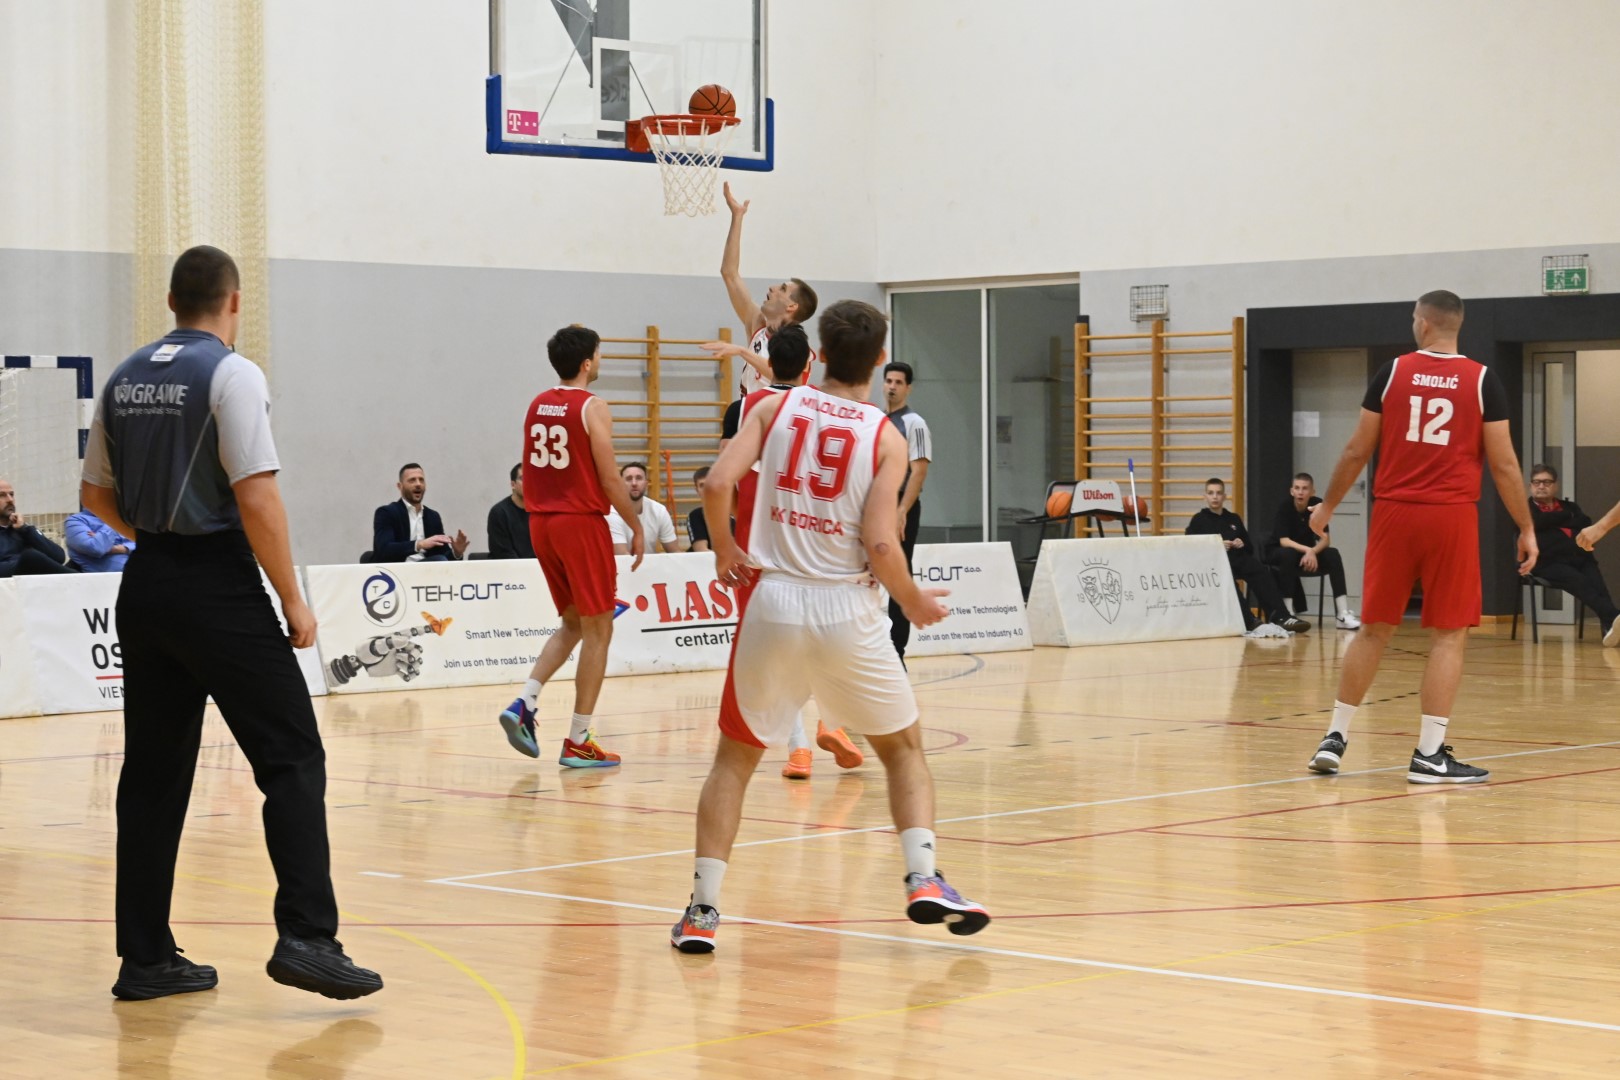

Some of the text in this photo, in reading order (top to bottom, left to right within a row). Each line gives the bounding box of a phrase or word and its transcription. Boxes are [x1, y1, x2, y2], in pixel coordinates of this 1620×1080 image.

[1411, 374, 1459, 389] SMOLIĆ
[131, 384, 189, 405] GRAWE
[1406, 395, 1454, 446] 12
[530, 423, 570, 470] 33
[775, 413, 859, 502] 19
[1082, 489, 1115, 500] Wilson
[770, 505, 844, 536] KK GORICA
[411, 583, 527, 602] TEH-CUT d.o.o.
[652, 579, 739, 623] LAS
[956, 607, 972, 615] New
[972, 604, 1018, 615] Technologies
[465, 630, 492, 640] Smart
[493, 629, 512, 638] New
[917, 633, 932, 641] Join
[942, 633, 950, 641] on
[951, 631, 962, 640] the
[963, 631, 977, 639] road
[986, 629, 1012, 638] Industry
[443, 659, 461, 668] Join
[474, 659, 485, 667] on
[485, 657, 499, 665] the
[500, 656, 518, 665] road
[518, 656, 528, 664] to
